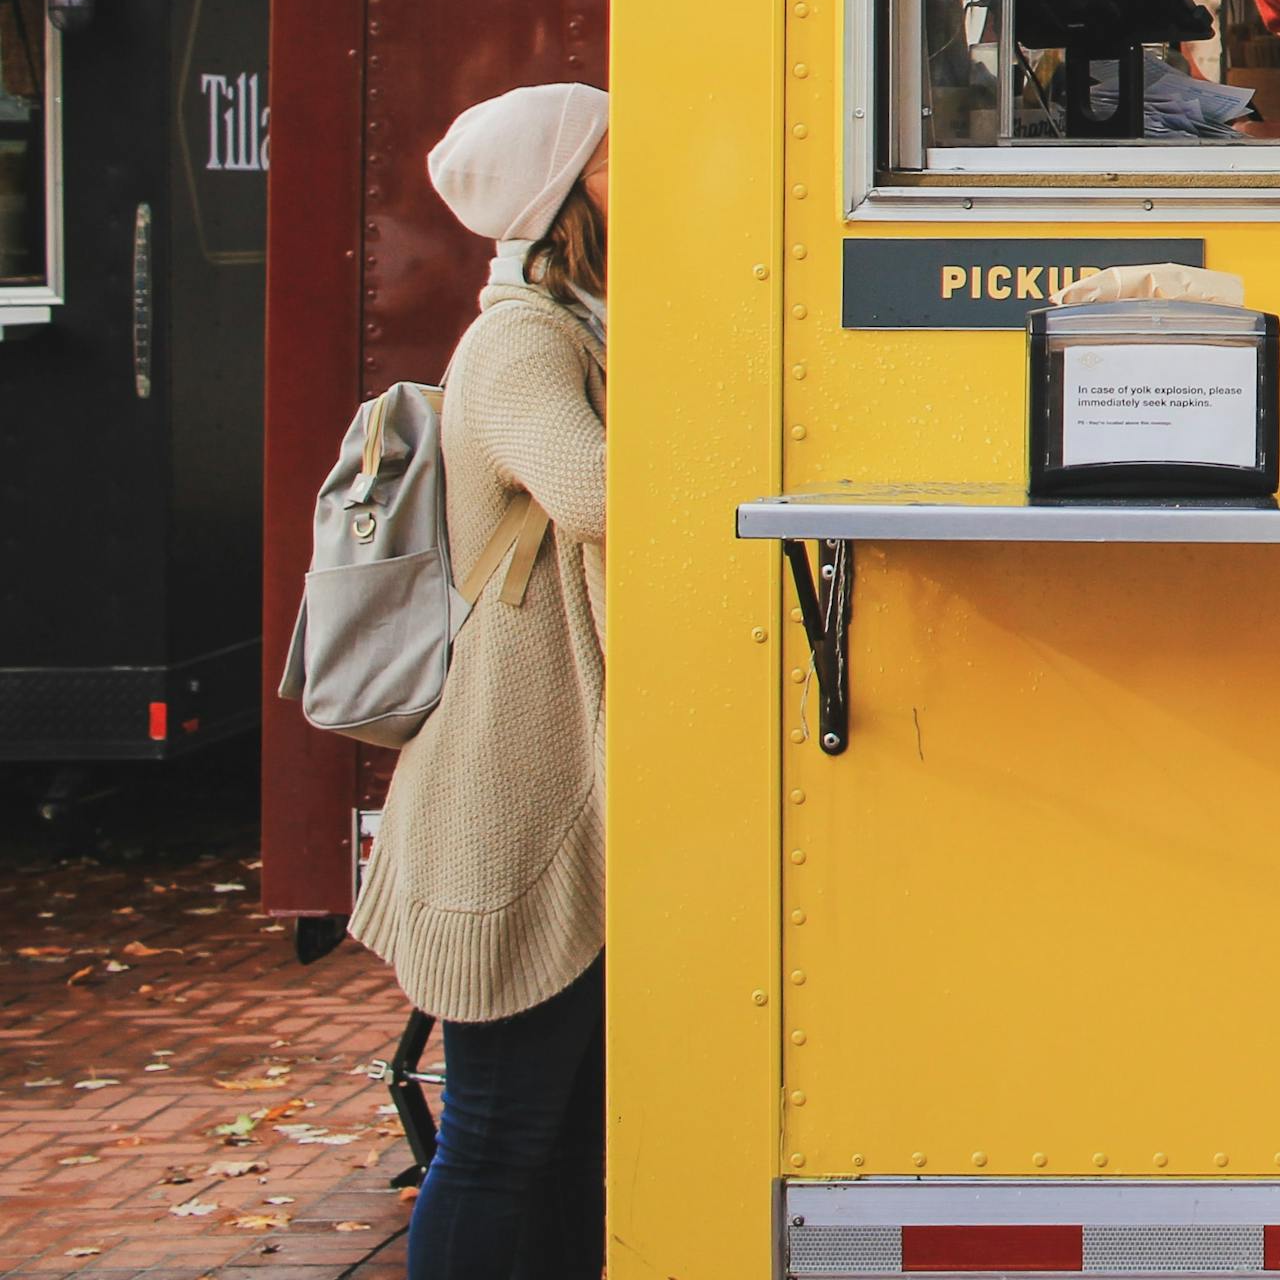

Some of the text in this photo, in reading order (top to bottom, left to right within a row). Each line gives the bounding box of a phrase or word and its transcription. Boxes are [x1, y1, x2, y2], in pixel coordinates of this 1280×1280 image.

[941, 265, 1102, 300] PICKU
[1077, 385, 1243, 397] In case of yolk explosion, please
[1077, 398, 1213, 409] immediately seek napkins.
